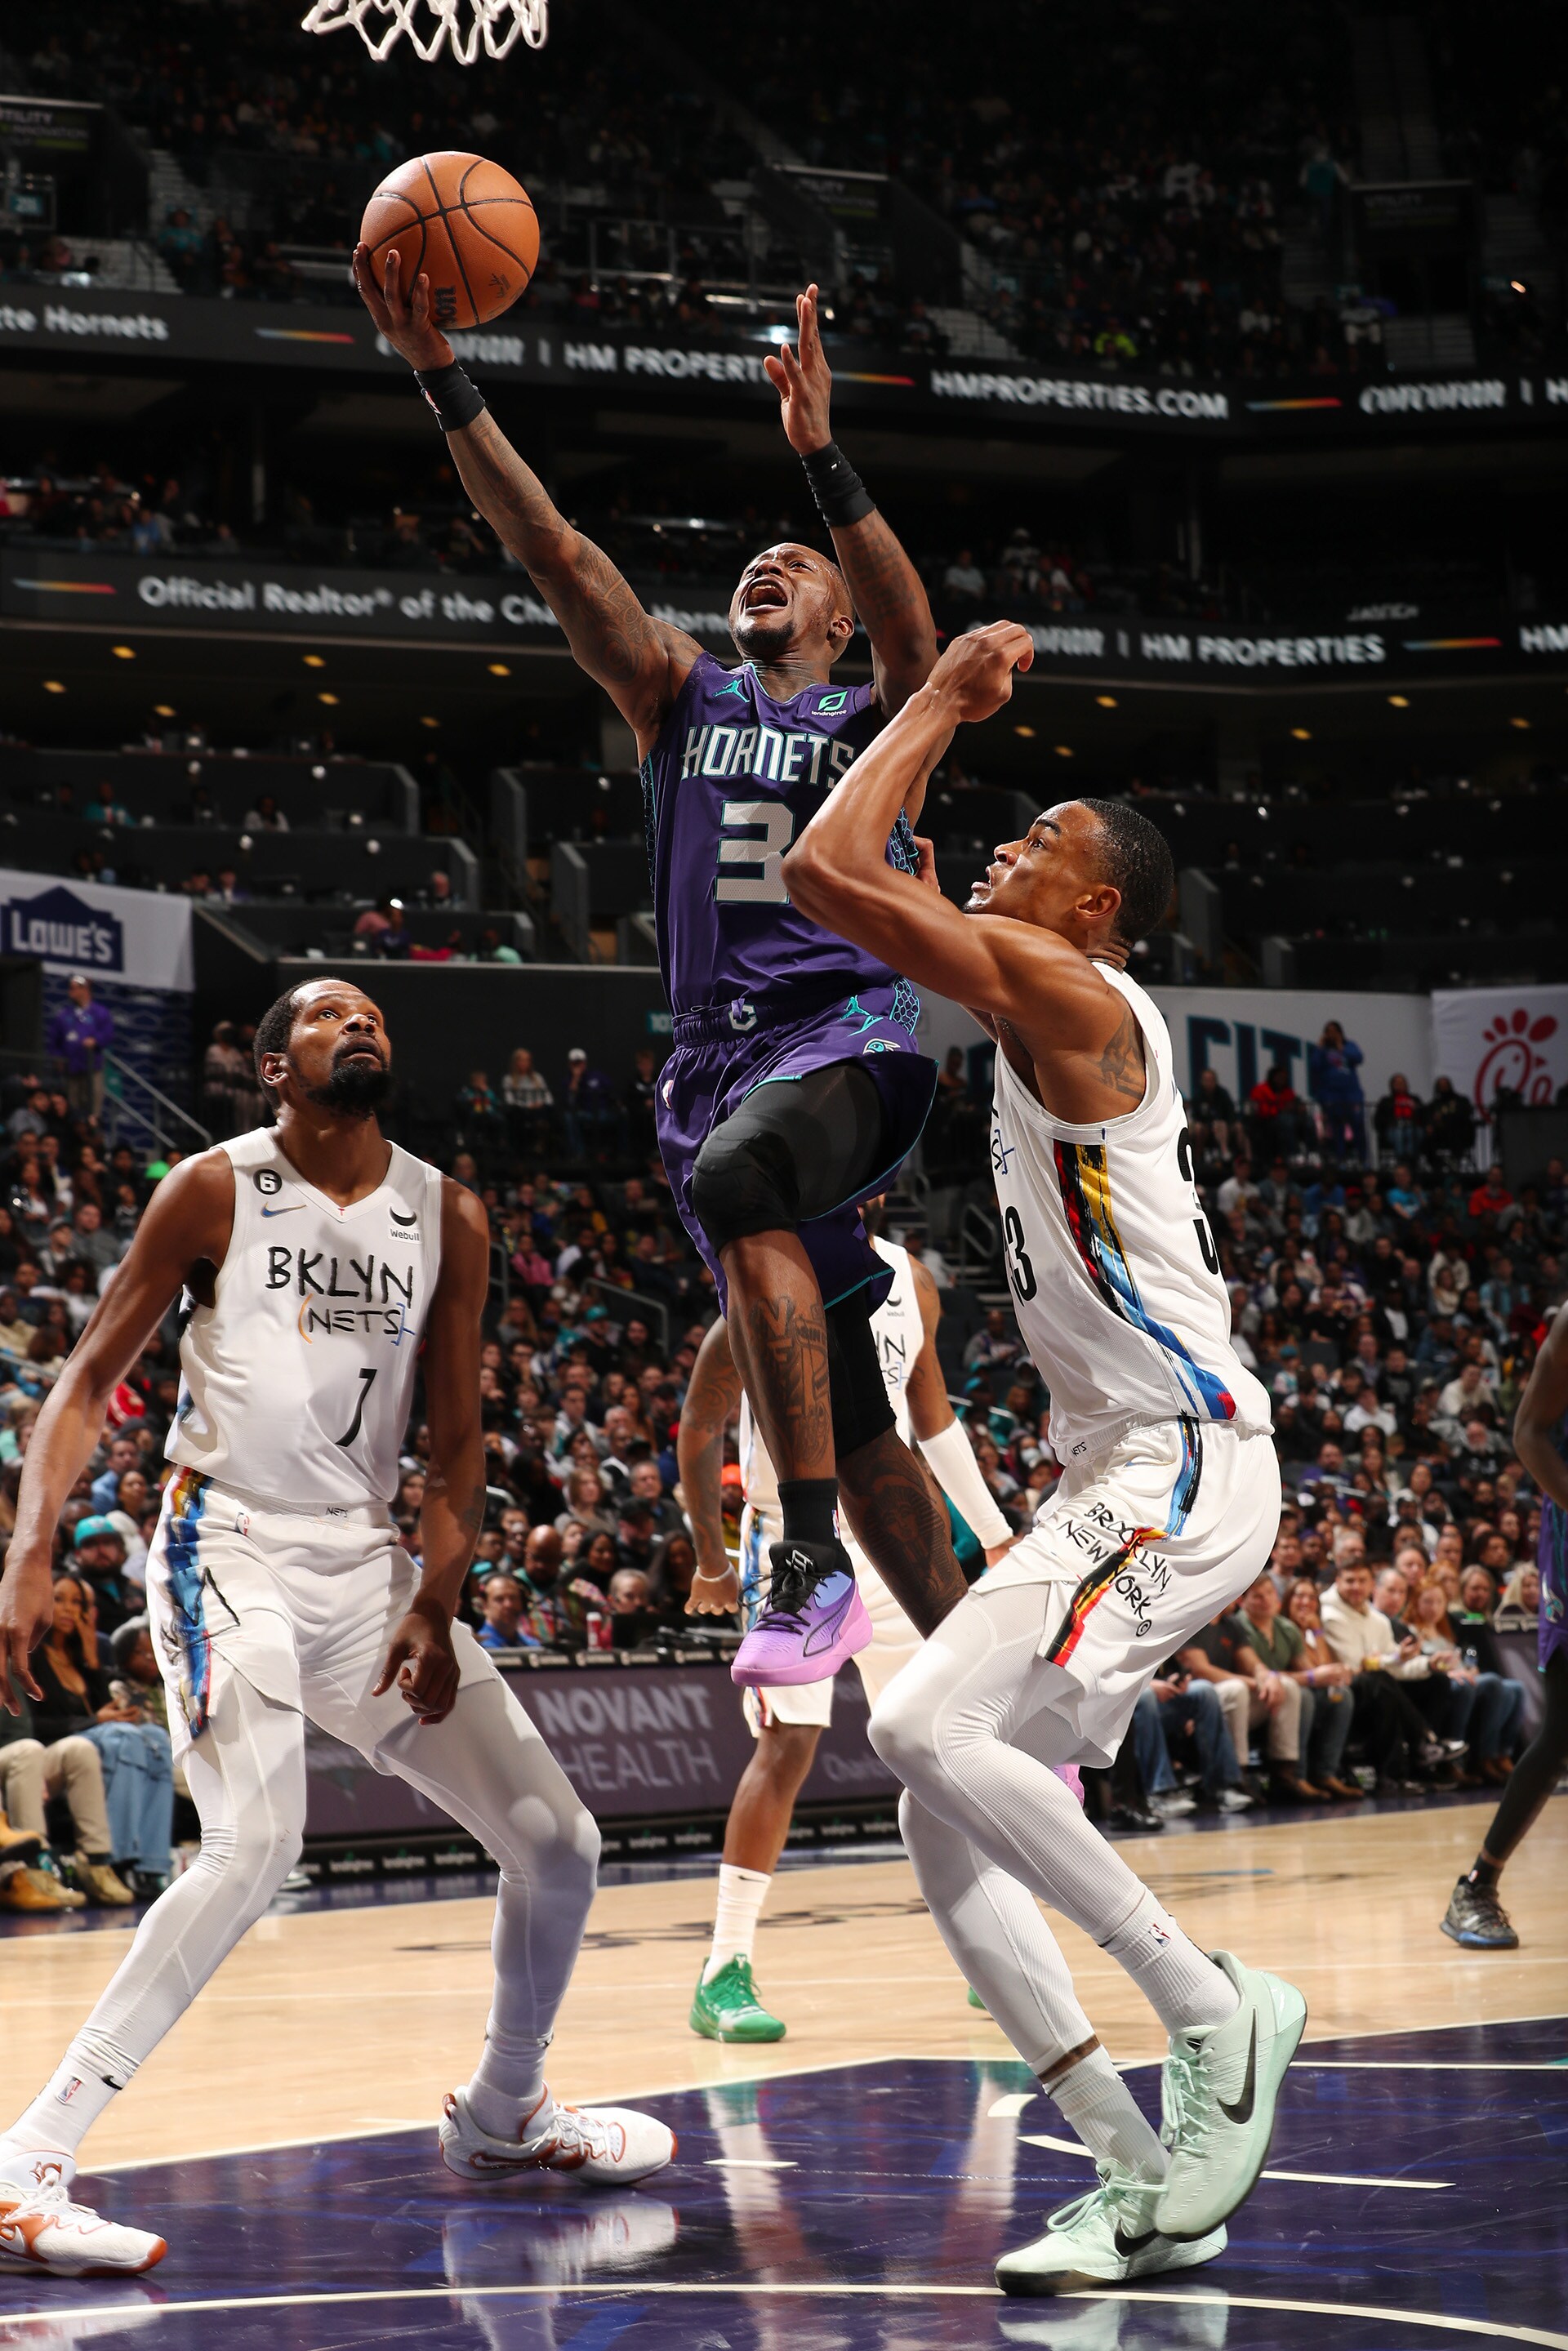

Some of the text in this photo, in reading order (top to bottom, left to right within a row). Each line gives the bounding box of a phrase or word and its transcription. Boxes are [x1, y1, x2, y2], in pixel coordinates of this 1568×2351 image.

[43, 305, 169, 341] Hornets
[564, 342, 617, 372] HM
[624, 345, 774, 384] PROPERT
[930, 370, 1229, 420] HMPROPERTIES.COM
[138, 576, 256, 611] Official
[399, 589, 435, 620] of
[441, 592, 493, 623] the
[1141, 632, 1192, 662] HM
[1198, 634, 1387, 666] PROPERTIES
[681, 724, 856, 790] HORNETS
[714, 800, 795, 904] 3
[11, 910, 113, 964] LOWE'S
[259, 1171, 277, 1192] 6
[390, 1228, 420, 1241] Webull
[265, 1246, 413, 1309] BKLYN
[334, 1367, 378, 1448] 7
[326, 1507, 348, 1518] NETS
[1055, 1518, 1110, 1565] NEW
[533, 1684, 713, 1737] NOVANT
[550, 1739, 721, 1792] HEALTH
